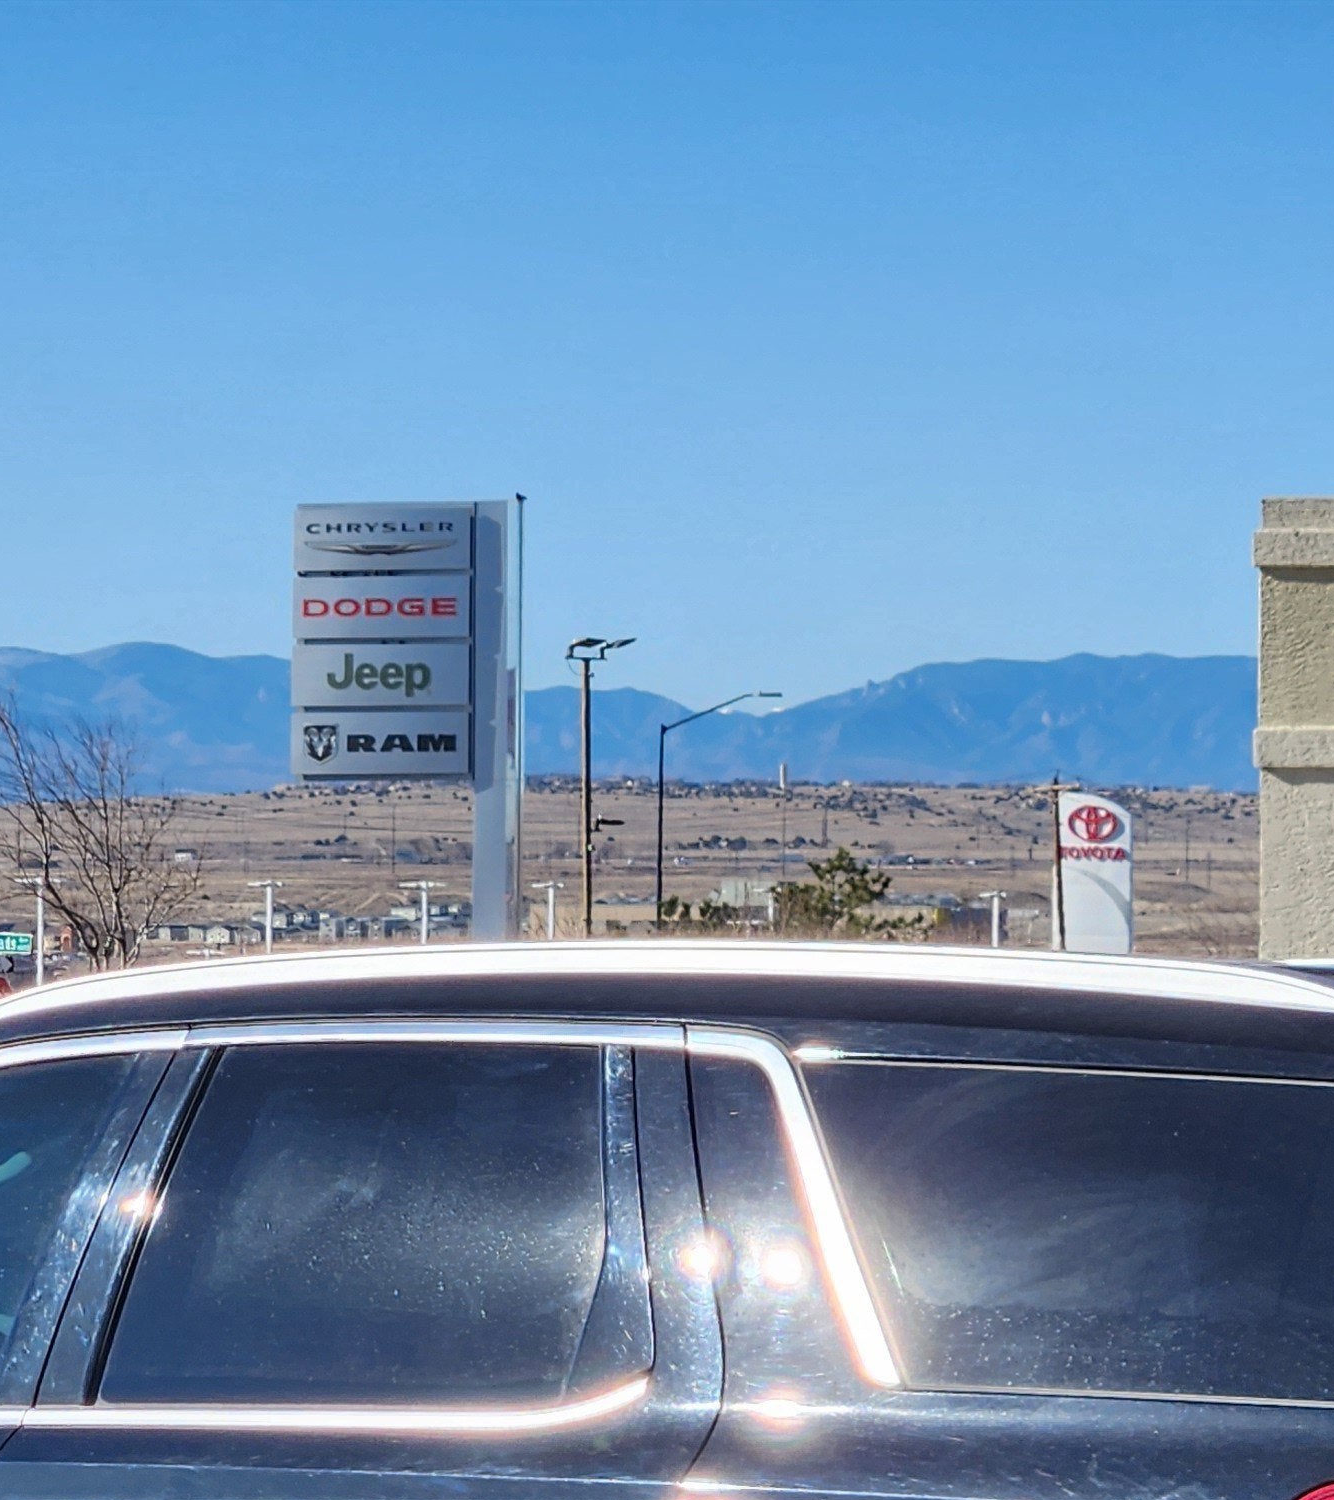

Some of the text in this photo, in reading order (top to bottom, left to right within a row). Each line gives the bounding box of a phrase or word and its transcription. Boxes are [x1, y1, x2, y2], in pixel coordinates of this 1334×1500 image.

[305, 521, 454, 535] CHRYSLER
[301, 597, 458, 619] DODGE
[326, 652, 432, 698] Jeep
[346, 733, 458, 753] RAM
[1059, 846, 1127, 862] TOYOTA
